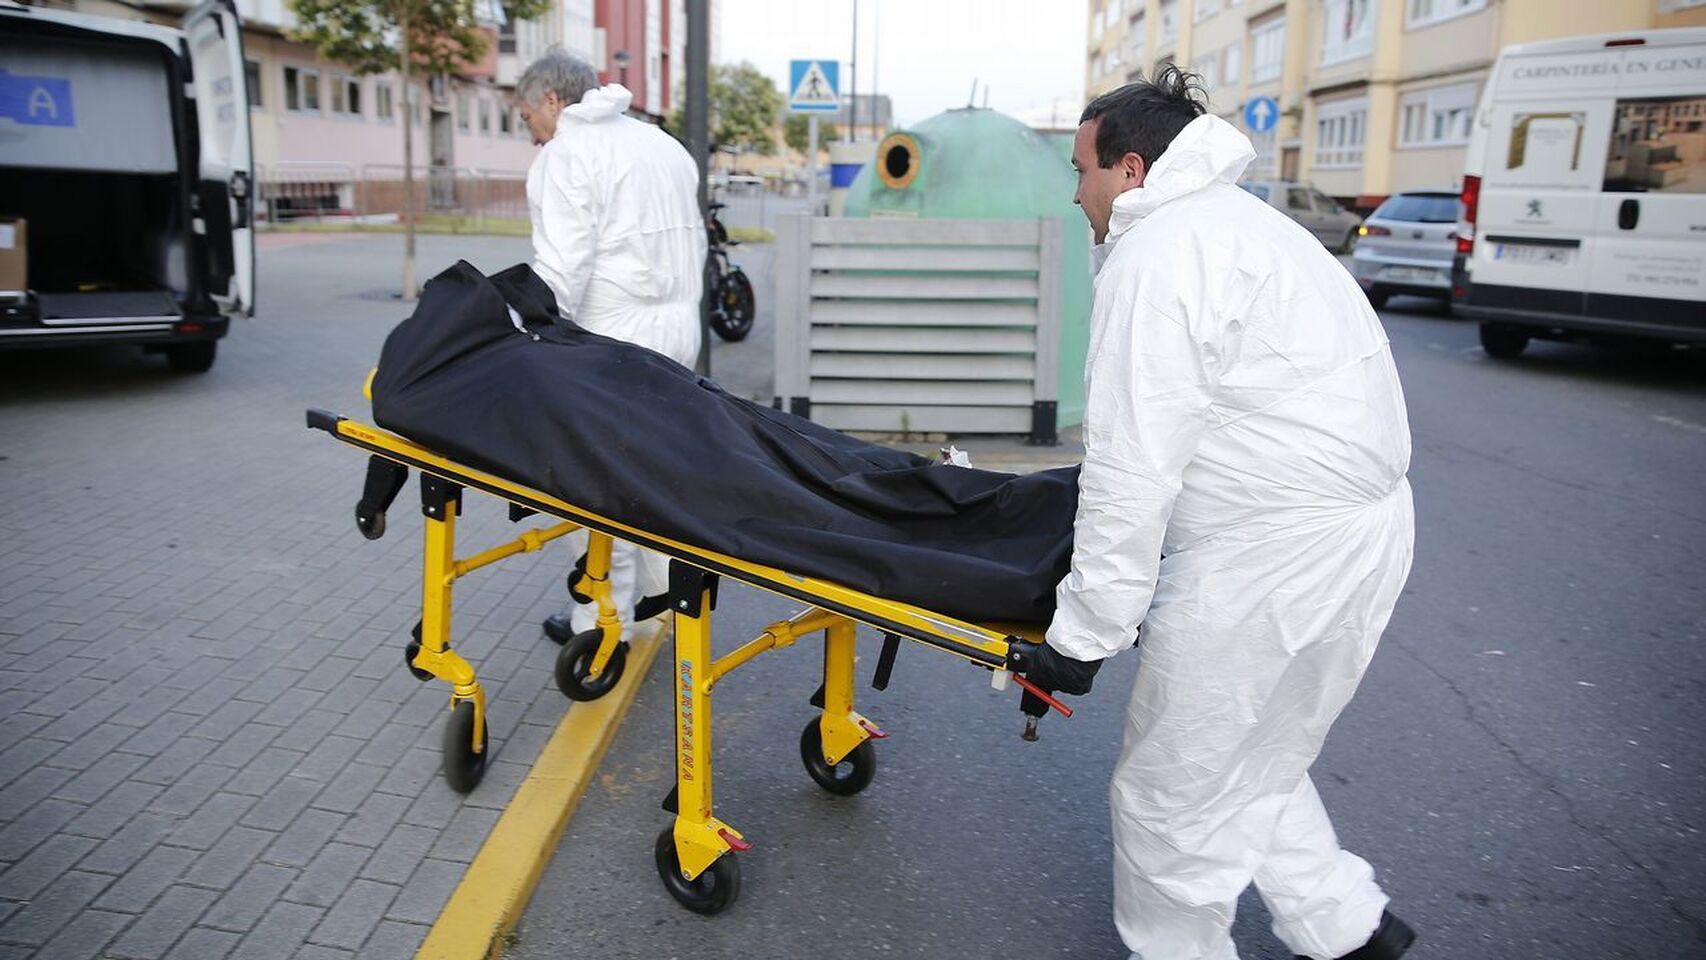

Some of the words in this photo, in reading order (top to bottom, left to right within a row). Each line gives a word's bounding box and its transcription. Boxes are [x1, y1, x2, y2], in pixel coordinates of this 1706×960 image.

[1512, 61, 1620, 80] CARPINTERÍA
[1625, 61, 1649, 74] EN
[28, 86, 58, 119] A
[681, 660, 693, 781] KARTSANA
